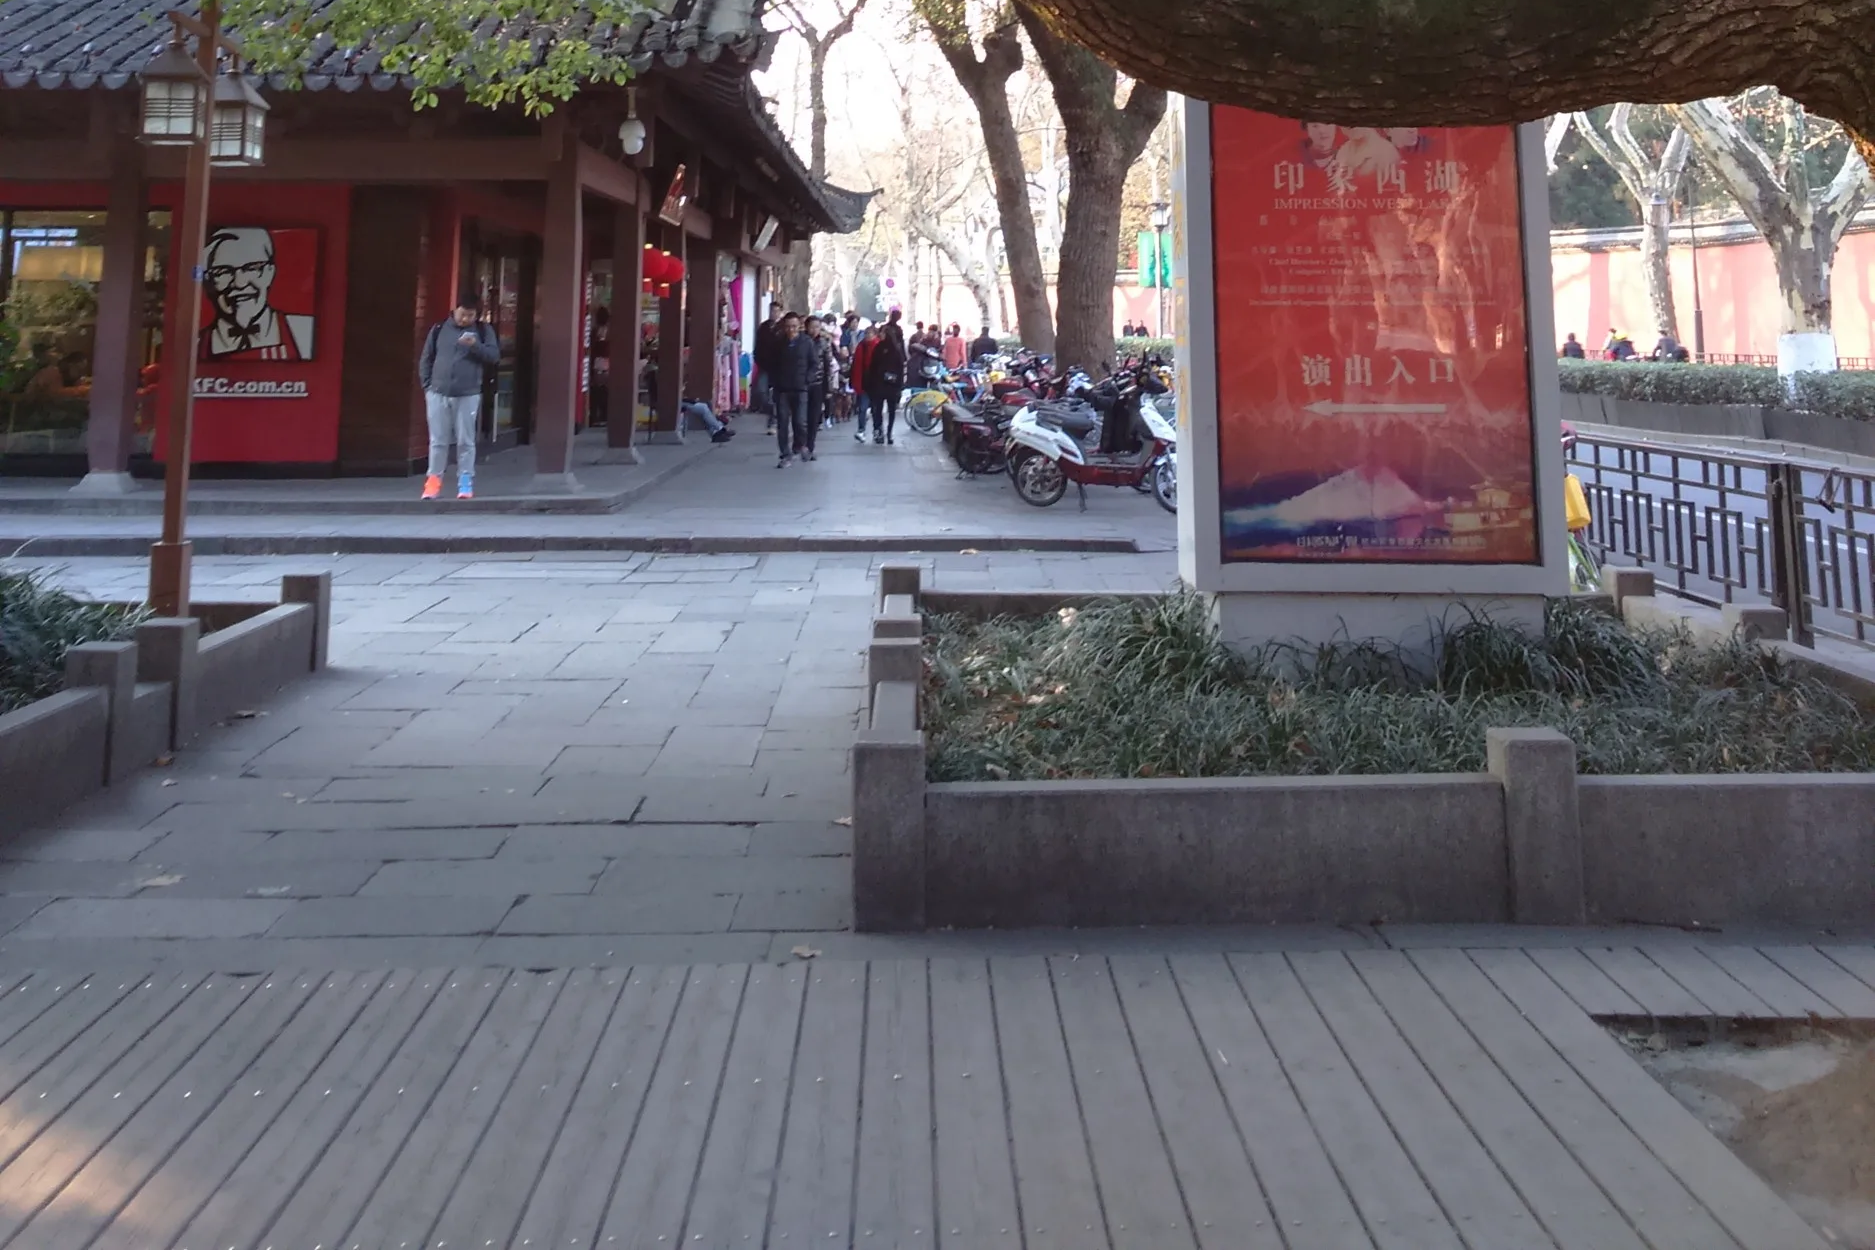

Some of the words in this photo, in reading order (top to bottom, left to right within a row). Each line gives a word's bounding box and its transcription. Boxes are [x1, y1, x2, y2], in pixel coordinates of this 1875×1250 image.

[1273, 159, 1461, 196] 印象西湖
[1273, 198, 1367, 210] IMPRESSION
[1371, 197, 1415, 210] WES
[1417, 197, 1464, 210] LAK
[1301, 353, 1454, 387] 演出入口
